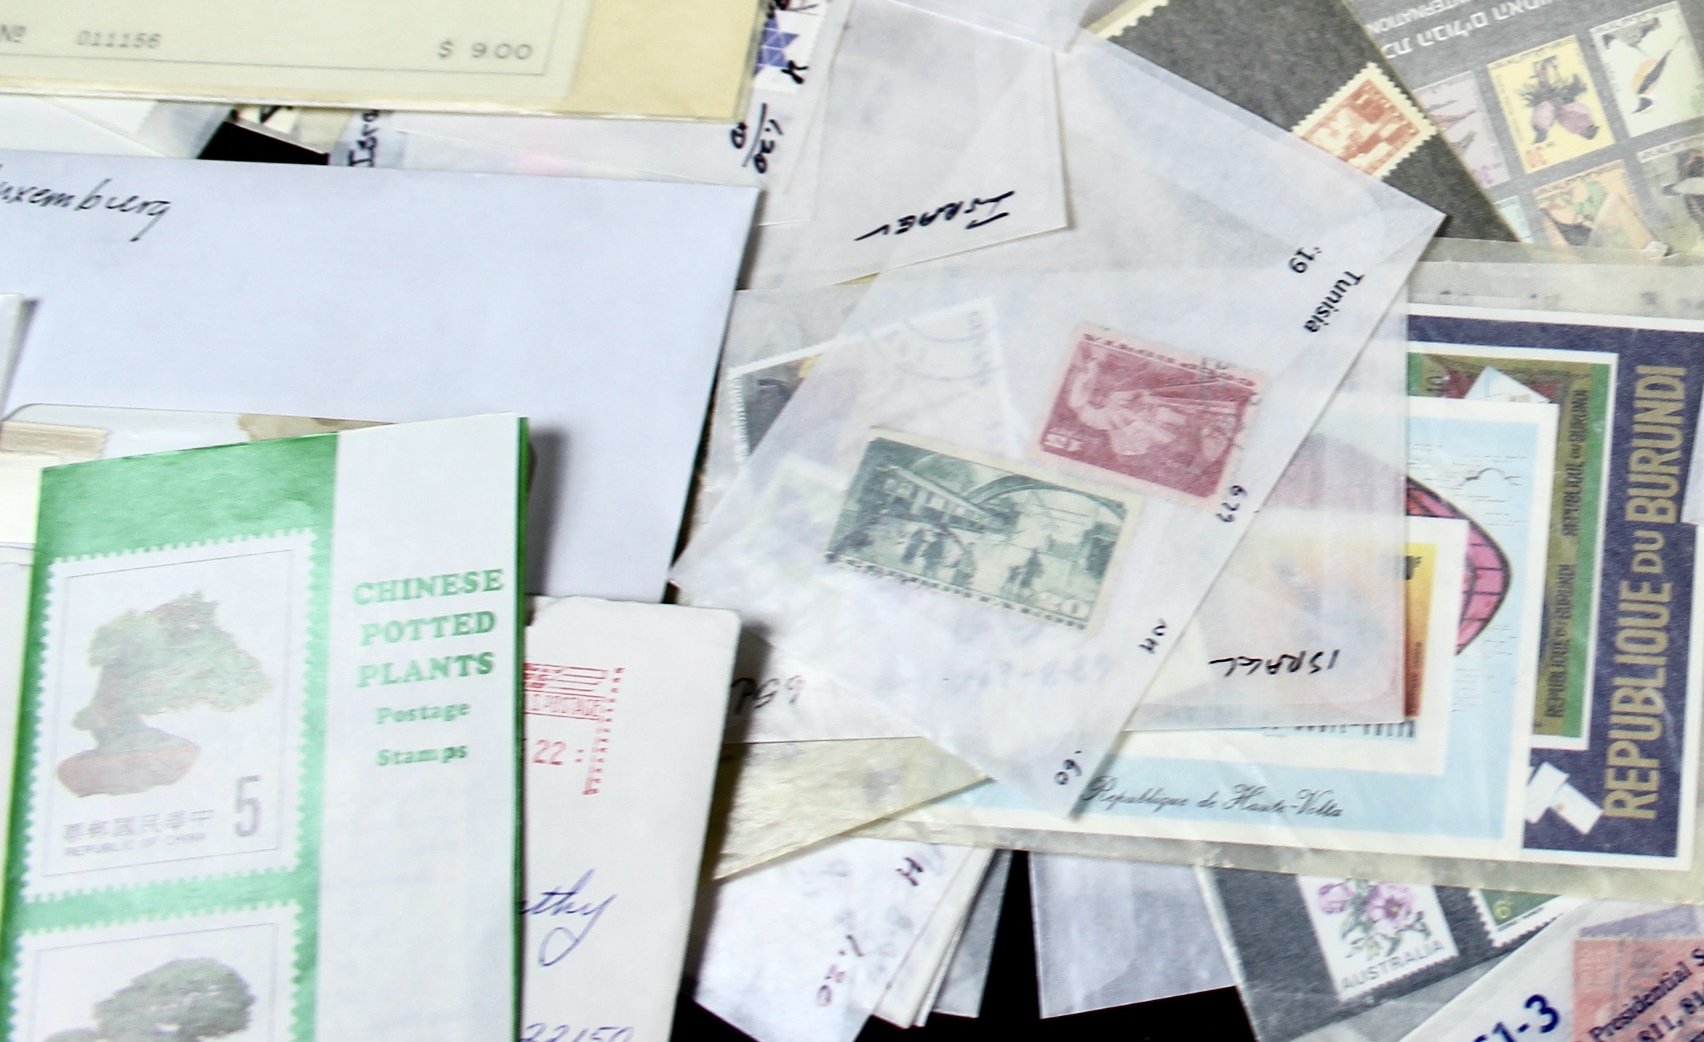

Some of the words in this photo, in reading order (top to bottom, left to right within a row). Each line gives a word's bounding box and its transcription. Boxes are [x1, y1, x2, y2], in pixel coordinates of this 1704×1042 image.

[1303, 269, 1366, 335] Tunisia
[1625, 364, 1688, 524] BURUNDI
[1632, 526, 1665, 576] DU
[352, 568, 505, 606] CHINESE
[360, 610, 497, 646] POTTED
[356, 651, 496, 689] PLANTS
[375, 701, 472, 726] Postage
[1603, 581, 1675, 820] REPUBLIQUE
[377, 742, 469, 769] Stamps
[234, 774, 262, 839] 5
[1199, 792, 1218, 809] de
[1339, 938, 1447, 994] AUSTRALIA
[1586, 960, 1695, 1042] Presidential
